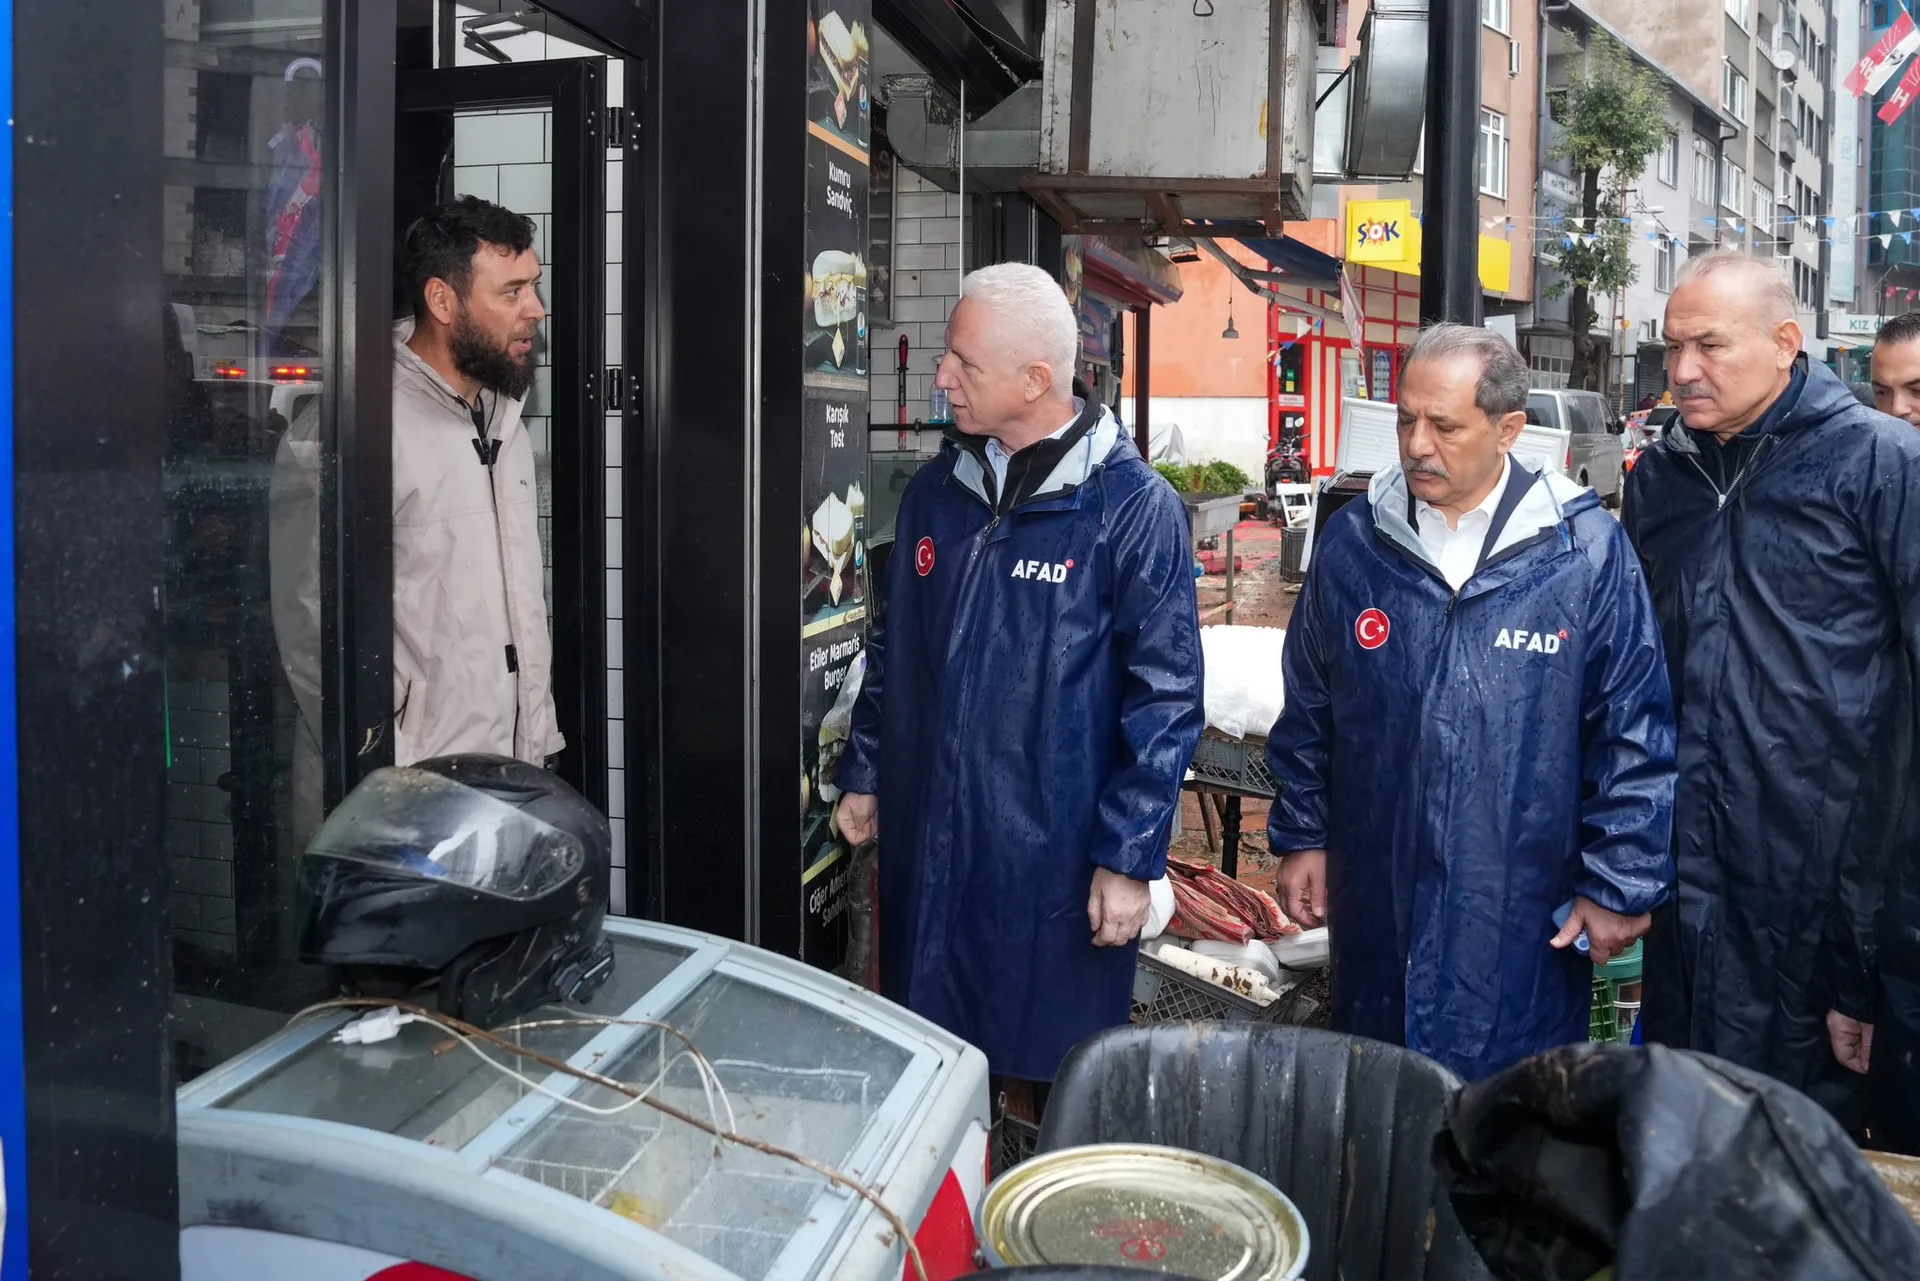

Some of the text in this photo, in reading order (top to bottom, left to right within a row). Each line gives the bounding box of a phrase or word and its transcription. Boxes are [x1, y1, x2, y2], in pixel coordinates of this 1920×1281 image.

[829, 161, 850, 188] Kumru
[827, 185, 852, 219] Sandviç
[1358, 219, 1400, 248] ŞOK
[826, 403, 849, 428] Karışık
[830, 429, 844, 448] Tost
[1011, 559, 1067, 583] AFAD
[810, 633, 860, 671] Etiler Marmaris
[1494, 628, 1560, 654] AFAD
[825, 665, 847, 690] Burger
[809, 886, 828, 914] Ciğer
